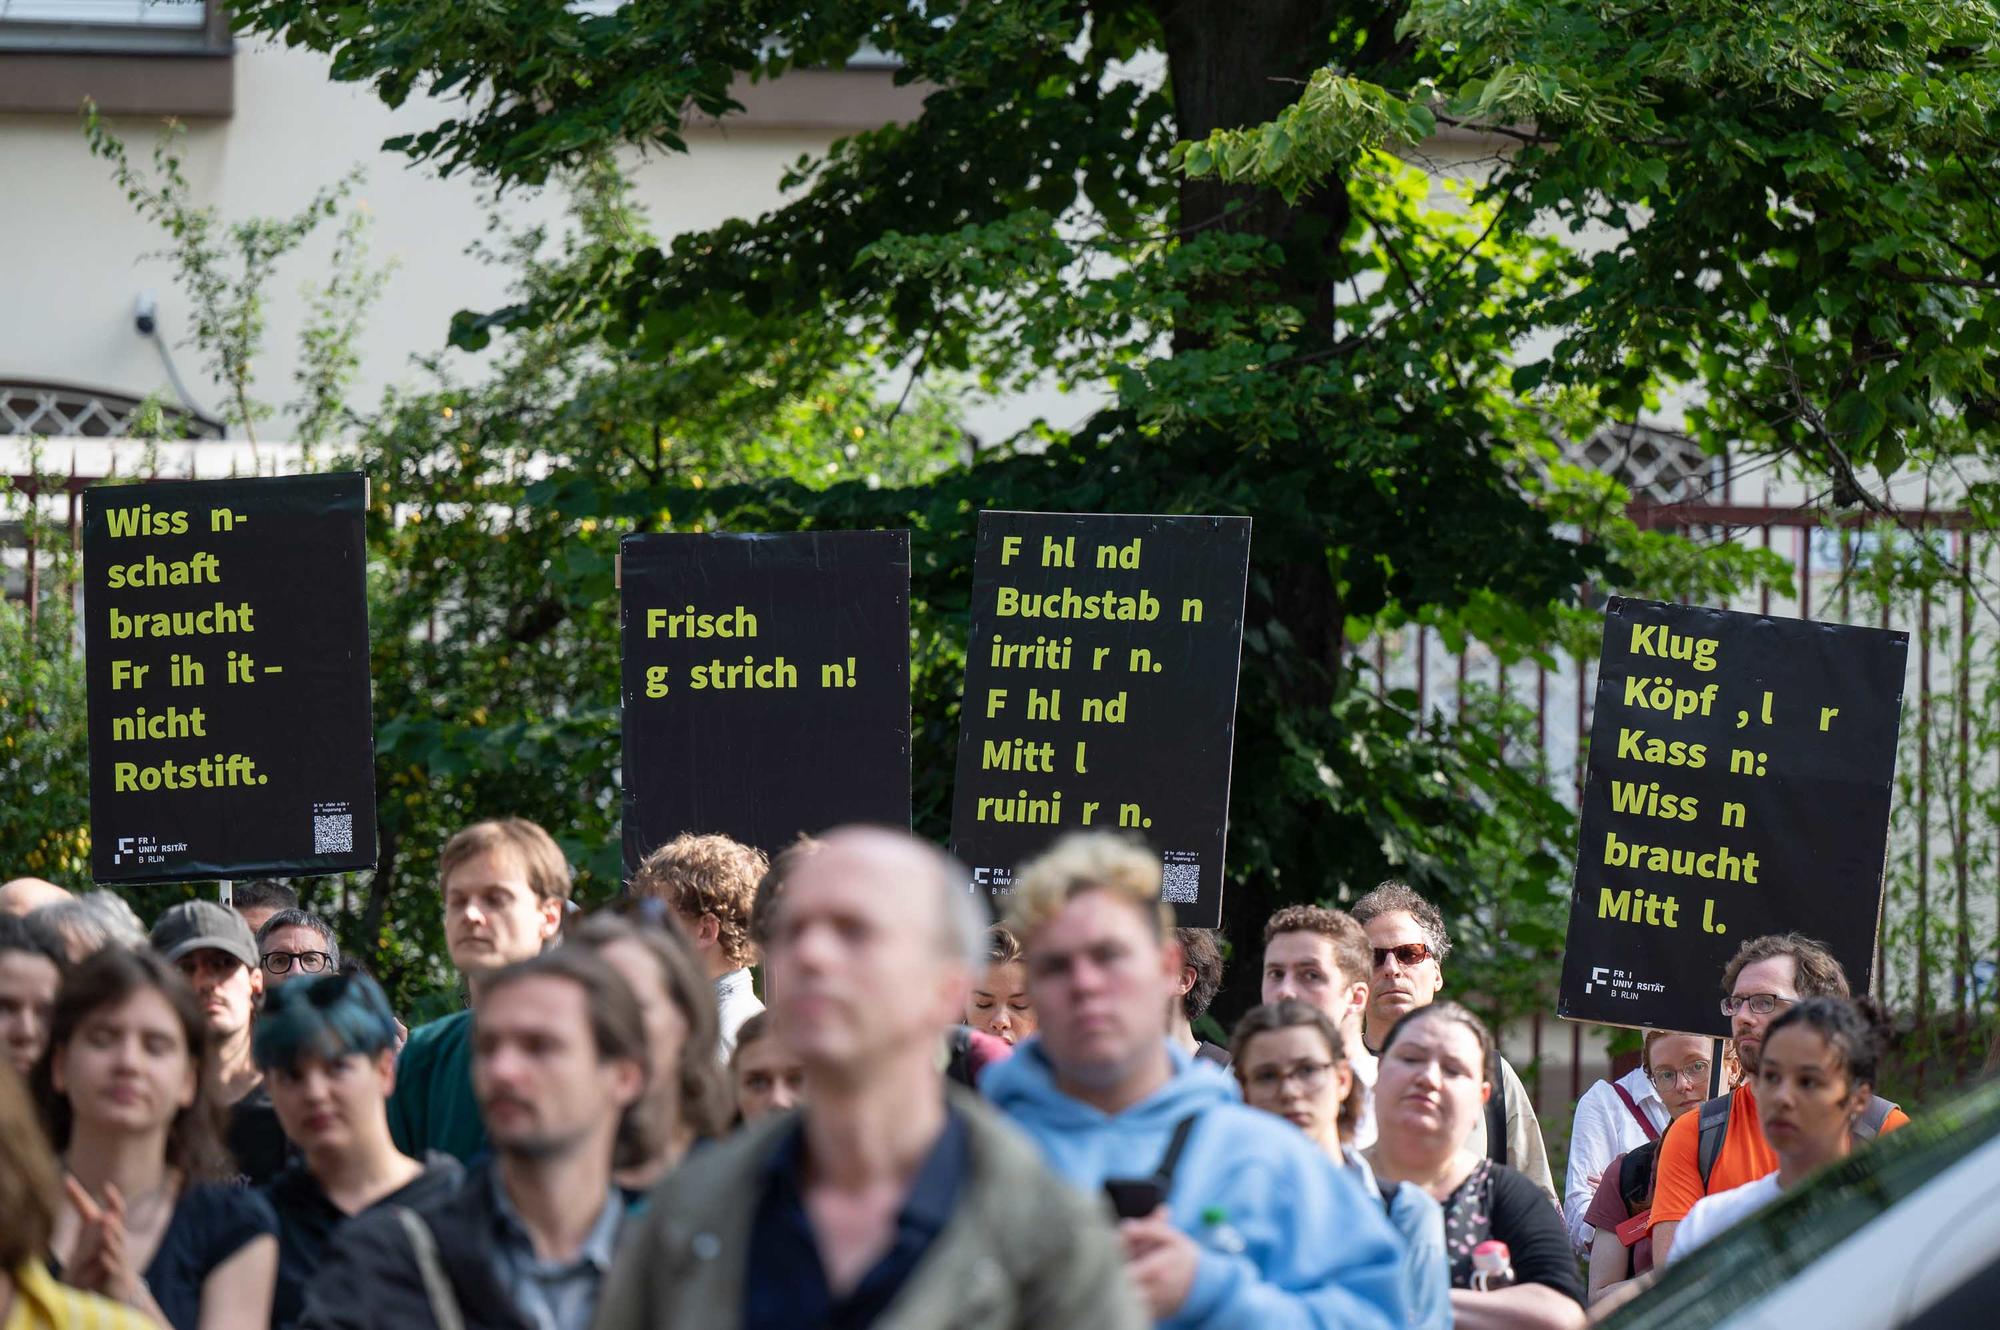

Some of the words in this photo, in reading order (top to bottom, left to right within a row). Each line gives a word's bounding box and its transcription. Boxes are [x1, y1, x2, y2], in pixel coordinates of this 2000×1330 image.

[107, 551, 221, 589] schaft
[109, 601, 255, 639] braucht
[646, 605, 758, 639] Frisch
[1629, 623, 1719, 672] Klug
[1623, 675, 1720, 721] Köpf
[112, 706, 207, 741] nicht
[114, 753, 269, 792] Rotstift.
[1602, 831, 1761, 884] braucht
